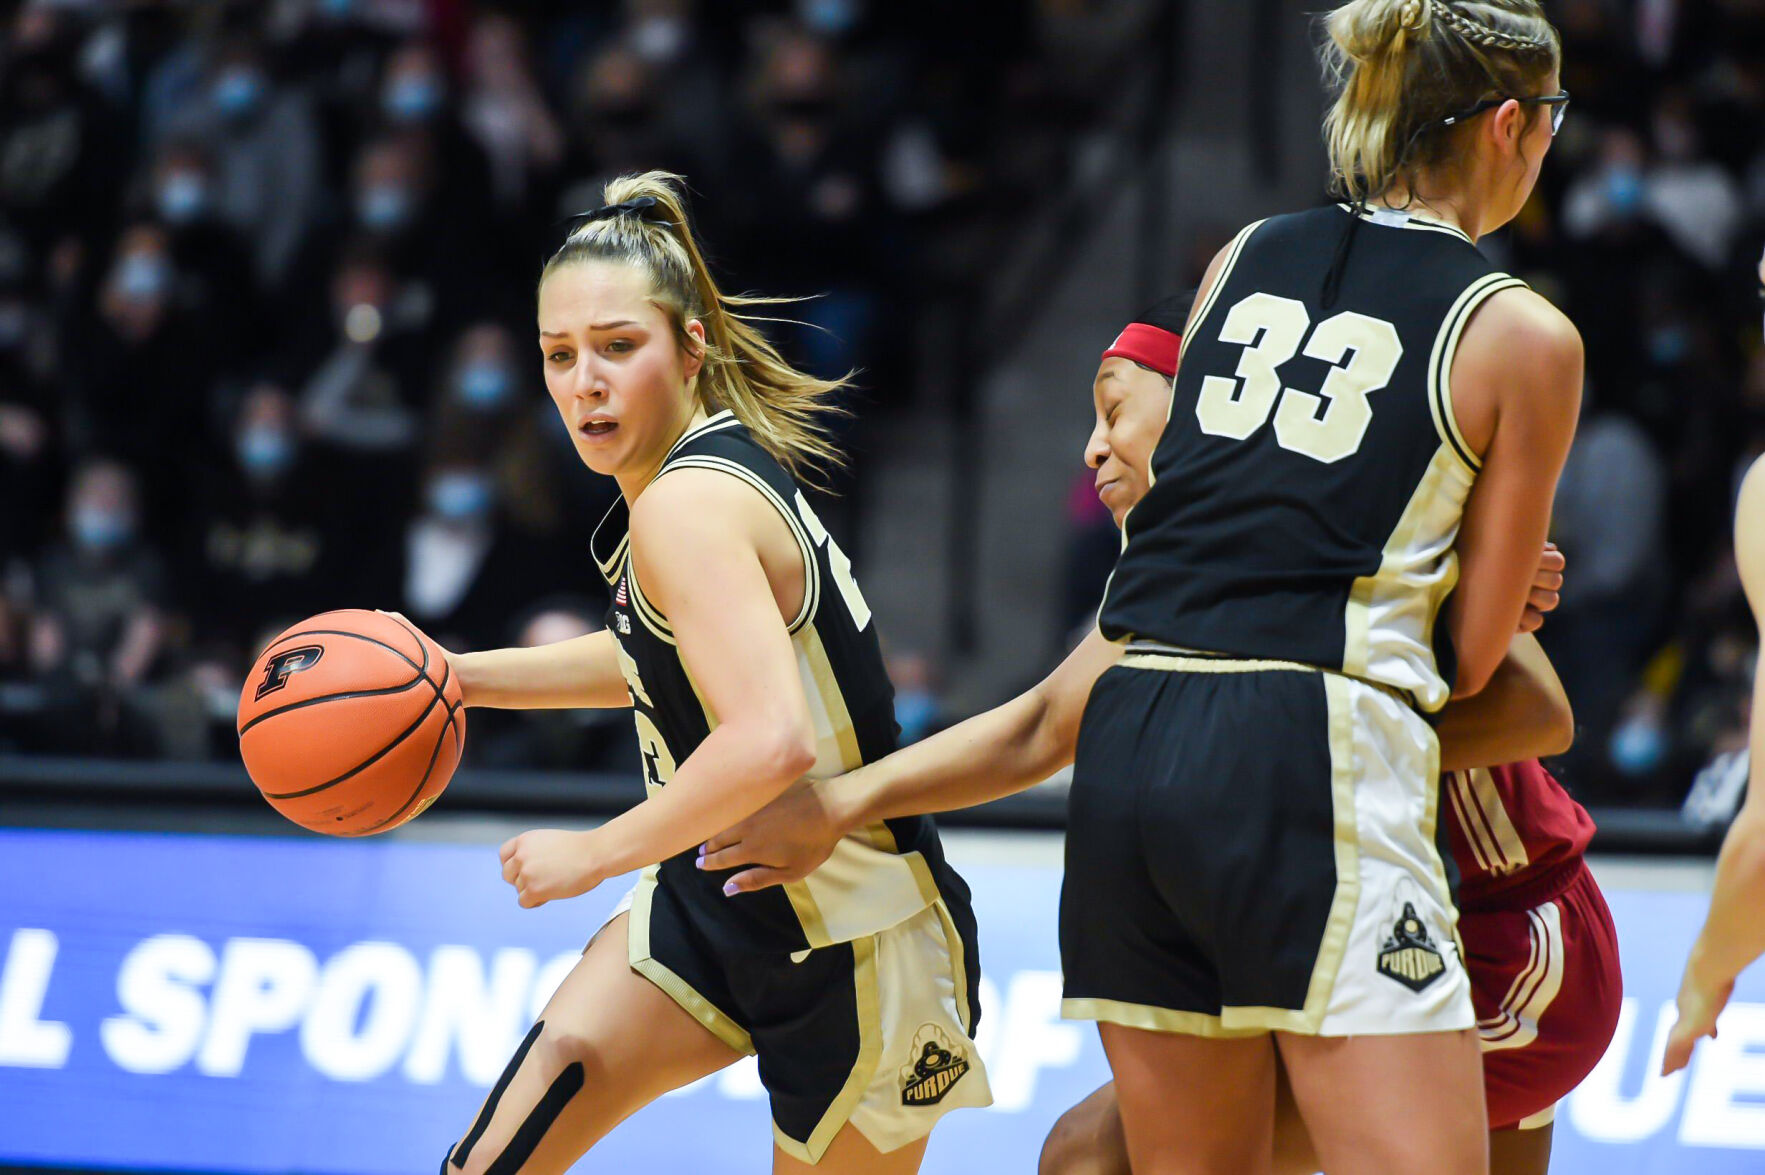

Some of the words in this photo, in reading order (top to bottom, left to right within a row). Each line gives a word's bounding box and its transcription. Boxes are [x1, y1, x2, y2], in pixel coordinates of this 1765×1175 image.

[1195, 292, 1404, 464] 33
[254, 644, 325, 703] P
[1381, 947, 1443, 981] PURDUE
[975, 969, 1082, 1114] F
[906, 1062, 965, 1101] PURDUE
